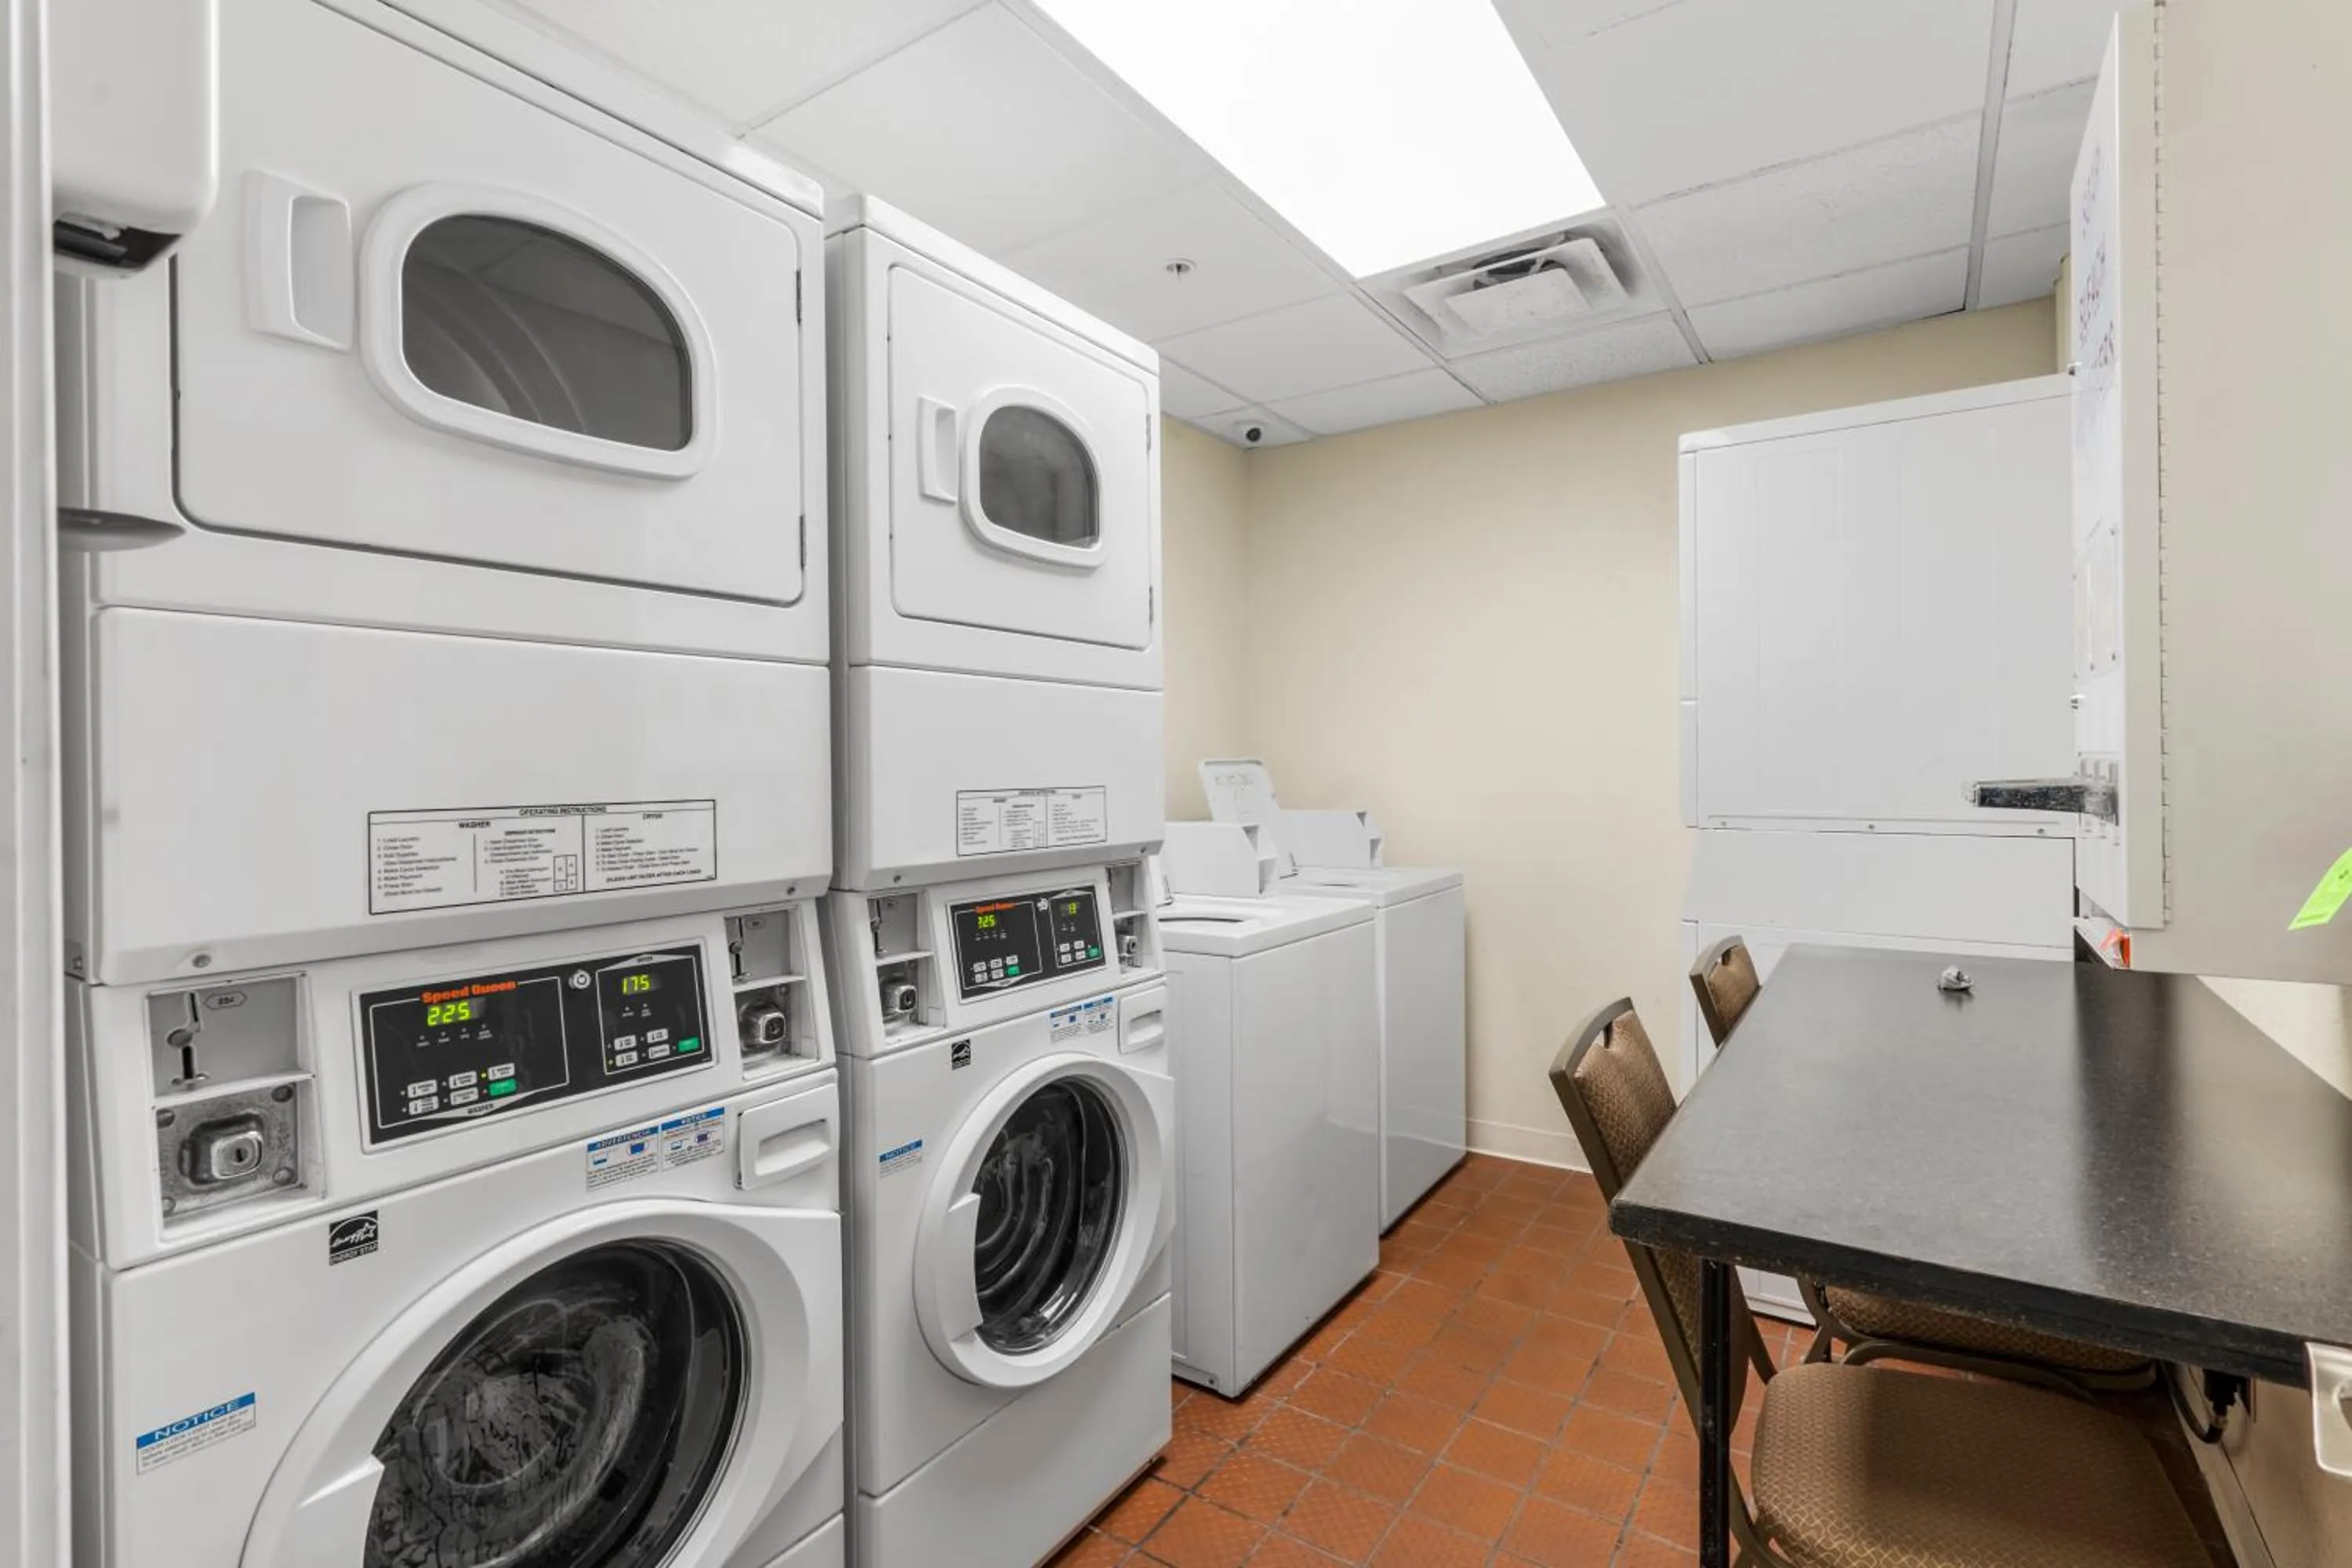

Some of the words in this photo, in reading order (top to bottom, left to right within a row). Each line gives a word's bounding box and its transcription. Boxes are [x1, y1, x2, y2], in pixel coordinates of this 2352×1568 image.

[421, 985, 470, 1004] Speed
[471, 981, 517, 996] Queen
[622, 975, 650, 995] 175
[427, 1000, 470, 1027] 225
[154, 1399, 240, 1439] NOTICE
